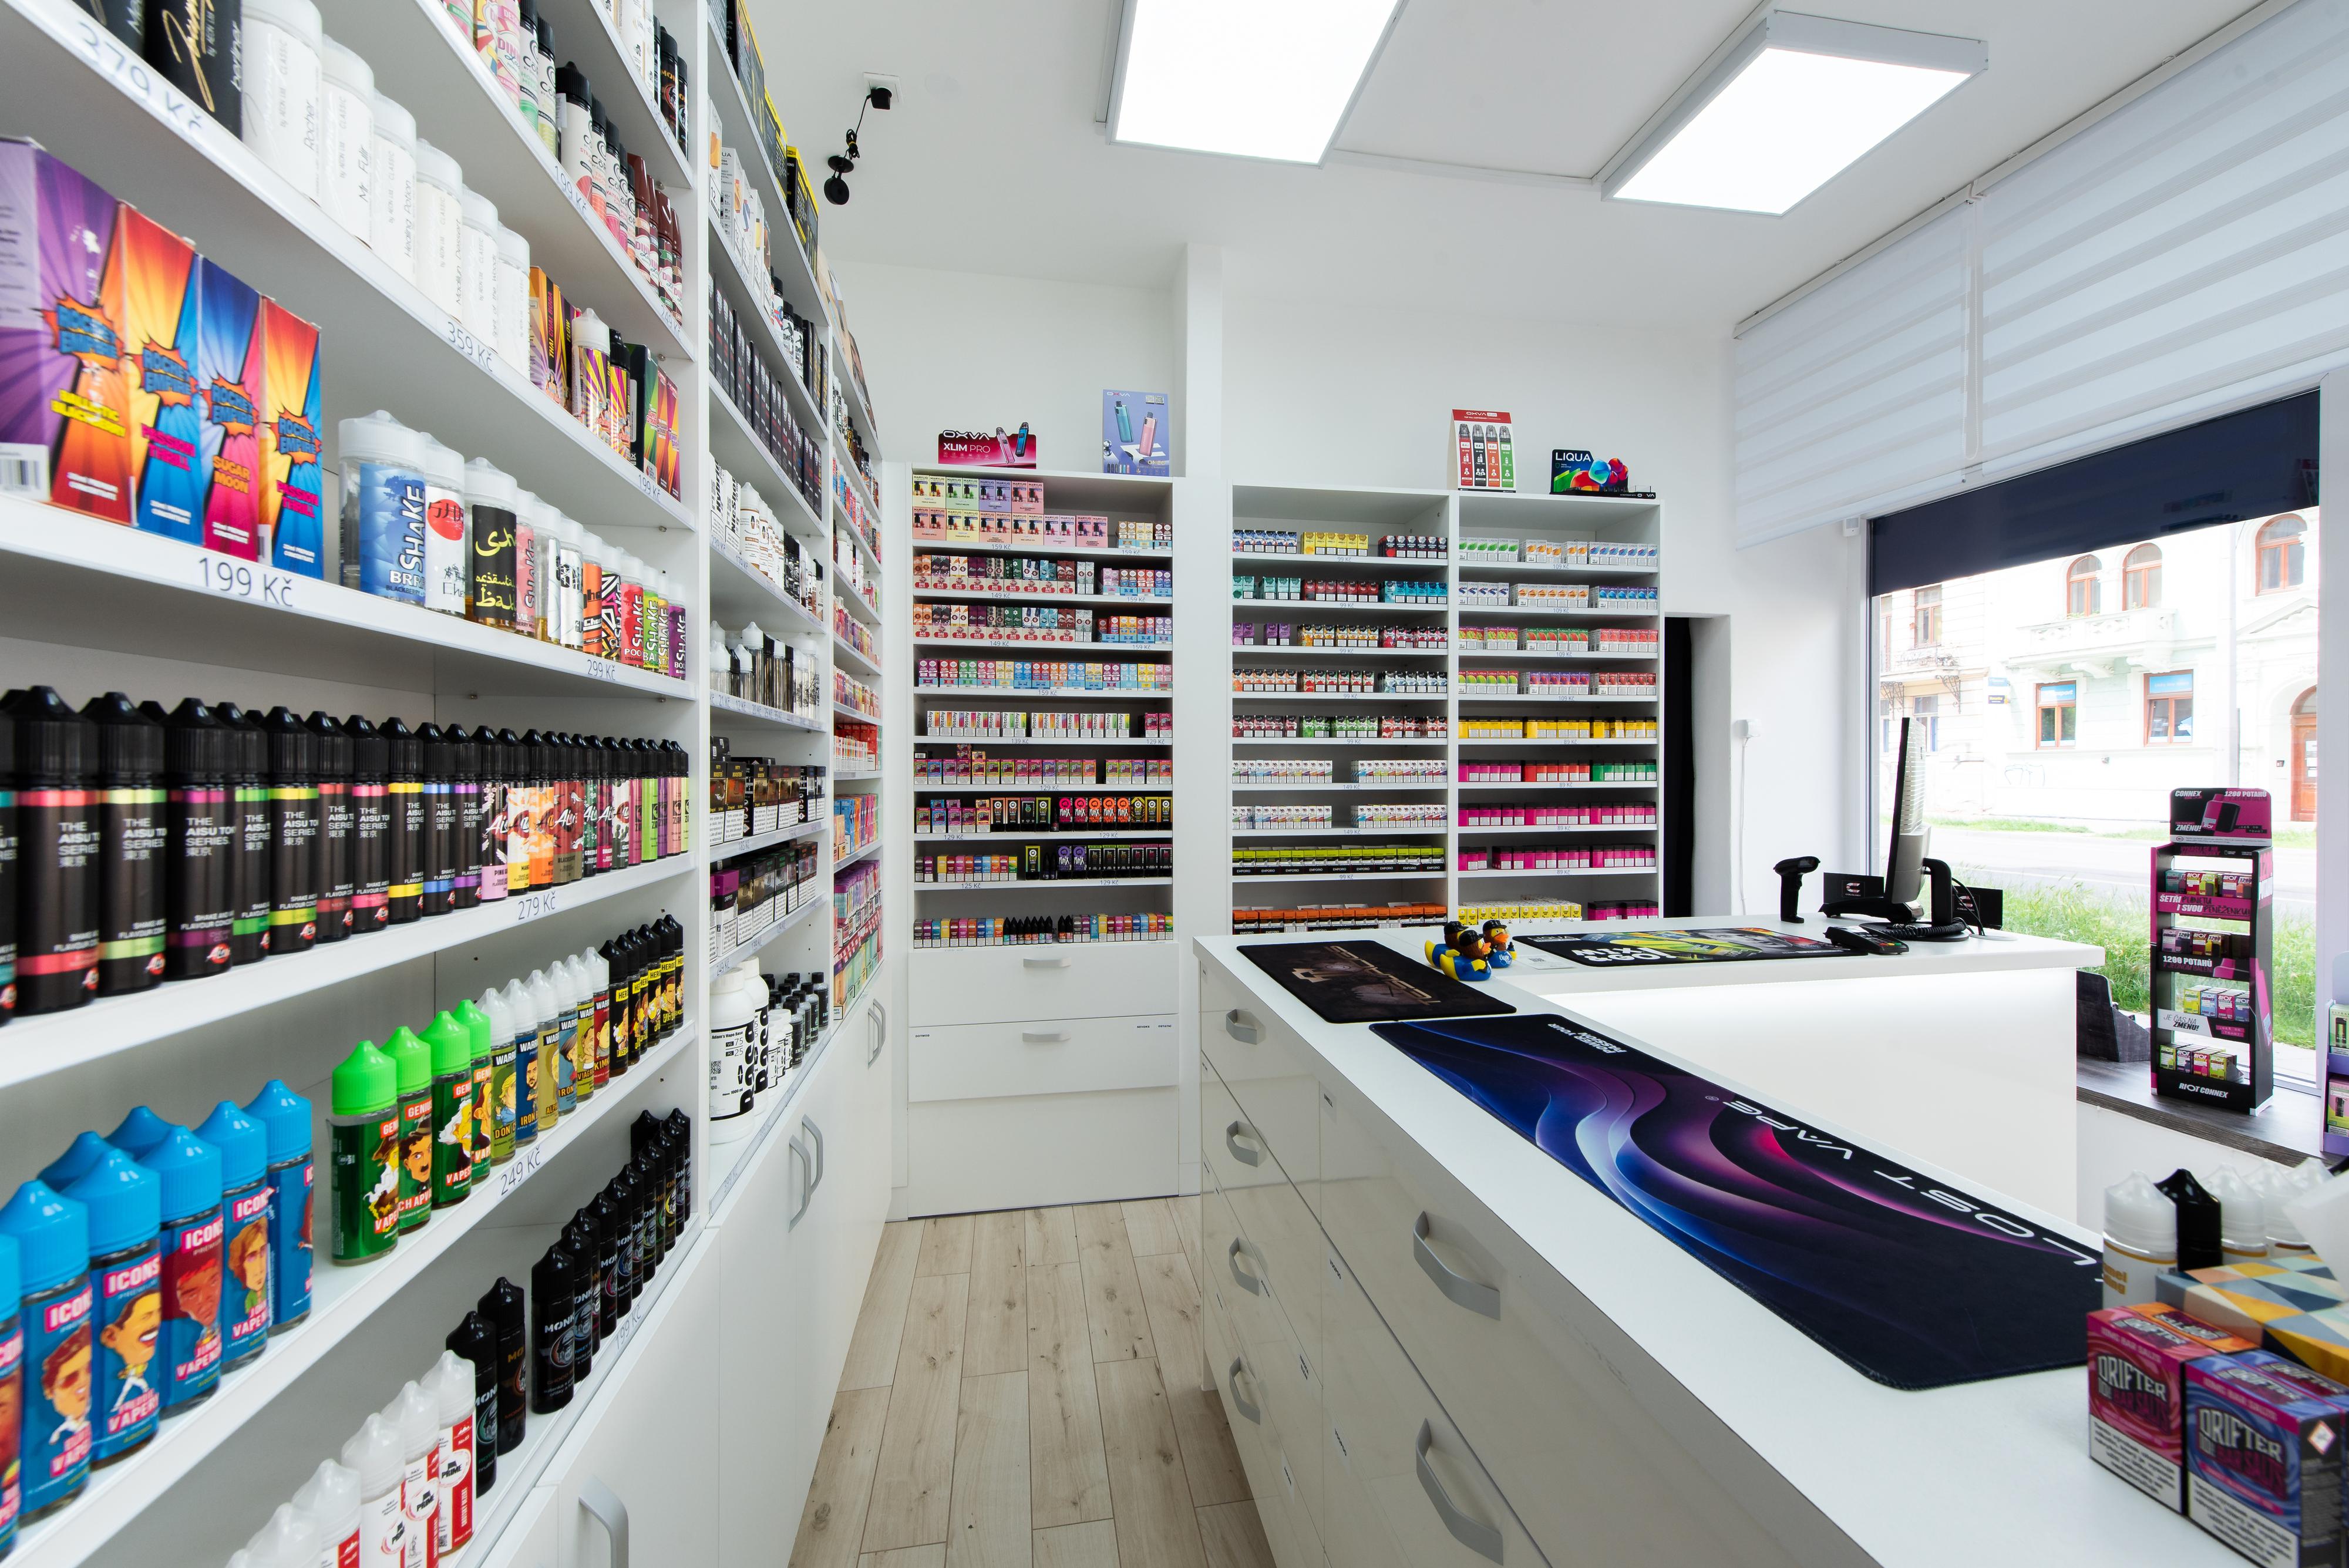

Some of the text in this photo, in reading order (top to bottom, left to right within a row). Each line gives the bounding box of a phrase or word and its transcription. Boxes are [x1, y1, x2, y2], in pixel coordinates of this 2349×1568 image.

[303, 99, 316, 151] Rocher
[554, 164, 574, 196] 199
[447, 321, 493, 372] 359 Kč
[943, 430, 990, 440] OXVA
[943, 442, 991, 453] XLIM PRO
[1555, 452, 1591, 462] LIQUA
[212, 455, 251, 482] SUGAR
[213, 470, 249, 494] MOON
[638, 474, 662, 501] 199 Kč
[276, 480, 319, 507] PASSION
[281, 496, 315, 518] THRILL
[398, 484, 426, 573] SHAKE
[198, 557, 293, 607] 199 Kč
[632, 594, 644, 648] SHAKE
[646, 600, 658, 652] SHAKE
[676, 614, 686, 661] SHAKE
[587, 659, 616, 681] 299 Kč
[186, 817, 213, 827] THE
[284, 810, 305, 819] THE
[284, 819, 308, 828] AISU
[359, 815, 381, 823] AISU
[185, 827, 218, 836] AISU
[284, 827, 317, 837] SERIES
[359, 822, 388, 831] SERIES
[185, 837, 230, 847] SERIES
[517, 890, 557, 921] 279 Kč
[2181, 904, 2203, 913] SVOU
[2163, 955, 2182, 963] 1200
[734, 1037, 743, 1046] 75
[1547, 1023, 1617, 1054] POWER YOUR
[1577, 1032, 1627, 1053] PASSION
[734, 1048, 743, 1056] 25
[2179, 1082, 2229, 1099] RIOT CONNEX
[520, 1112, 535, 1126] IRON
[500, 1145, 541, 1196] 249 Kč
[615, 1320, 633, 1351] 199
[2097, 1354, 2168, 1402] DRIFTER
[2198, 1408, 2284, 1462] DRIFTER
[442, 1463, 463, 1479] PRIME
[416, 1493, 435, 1512] PRIME
